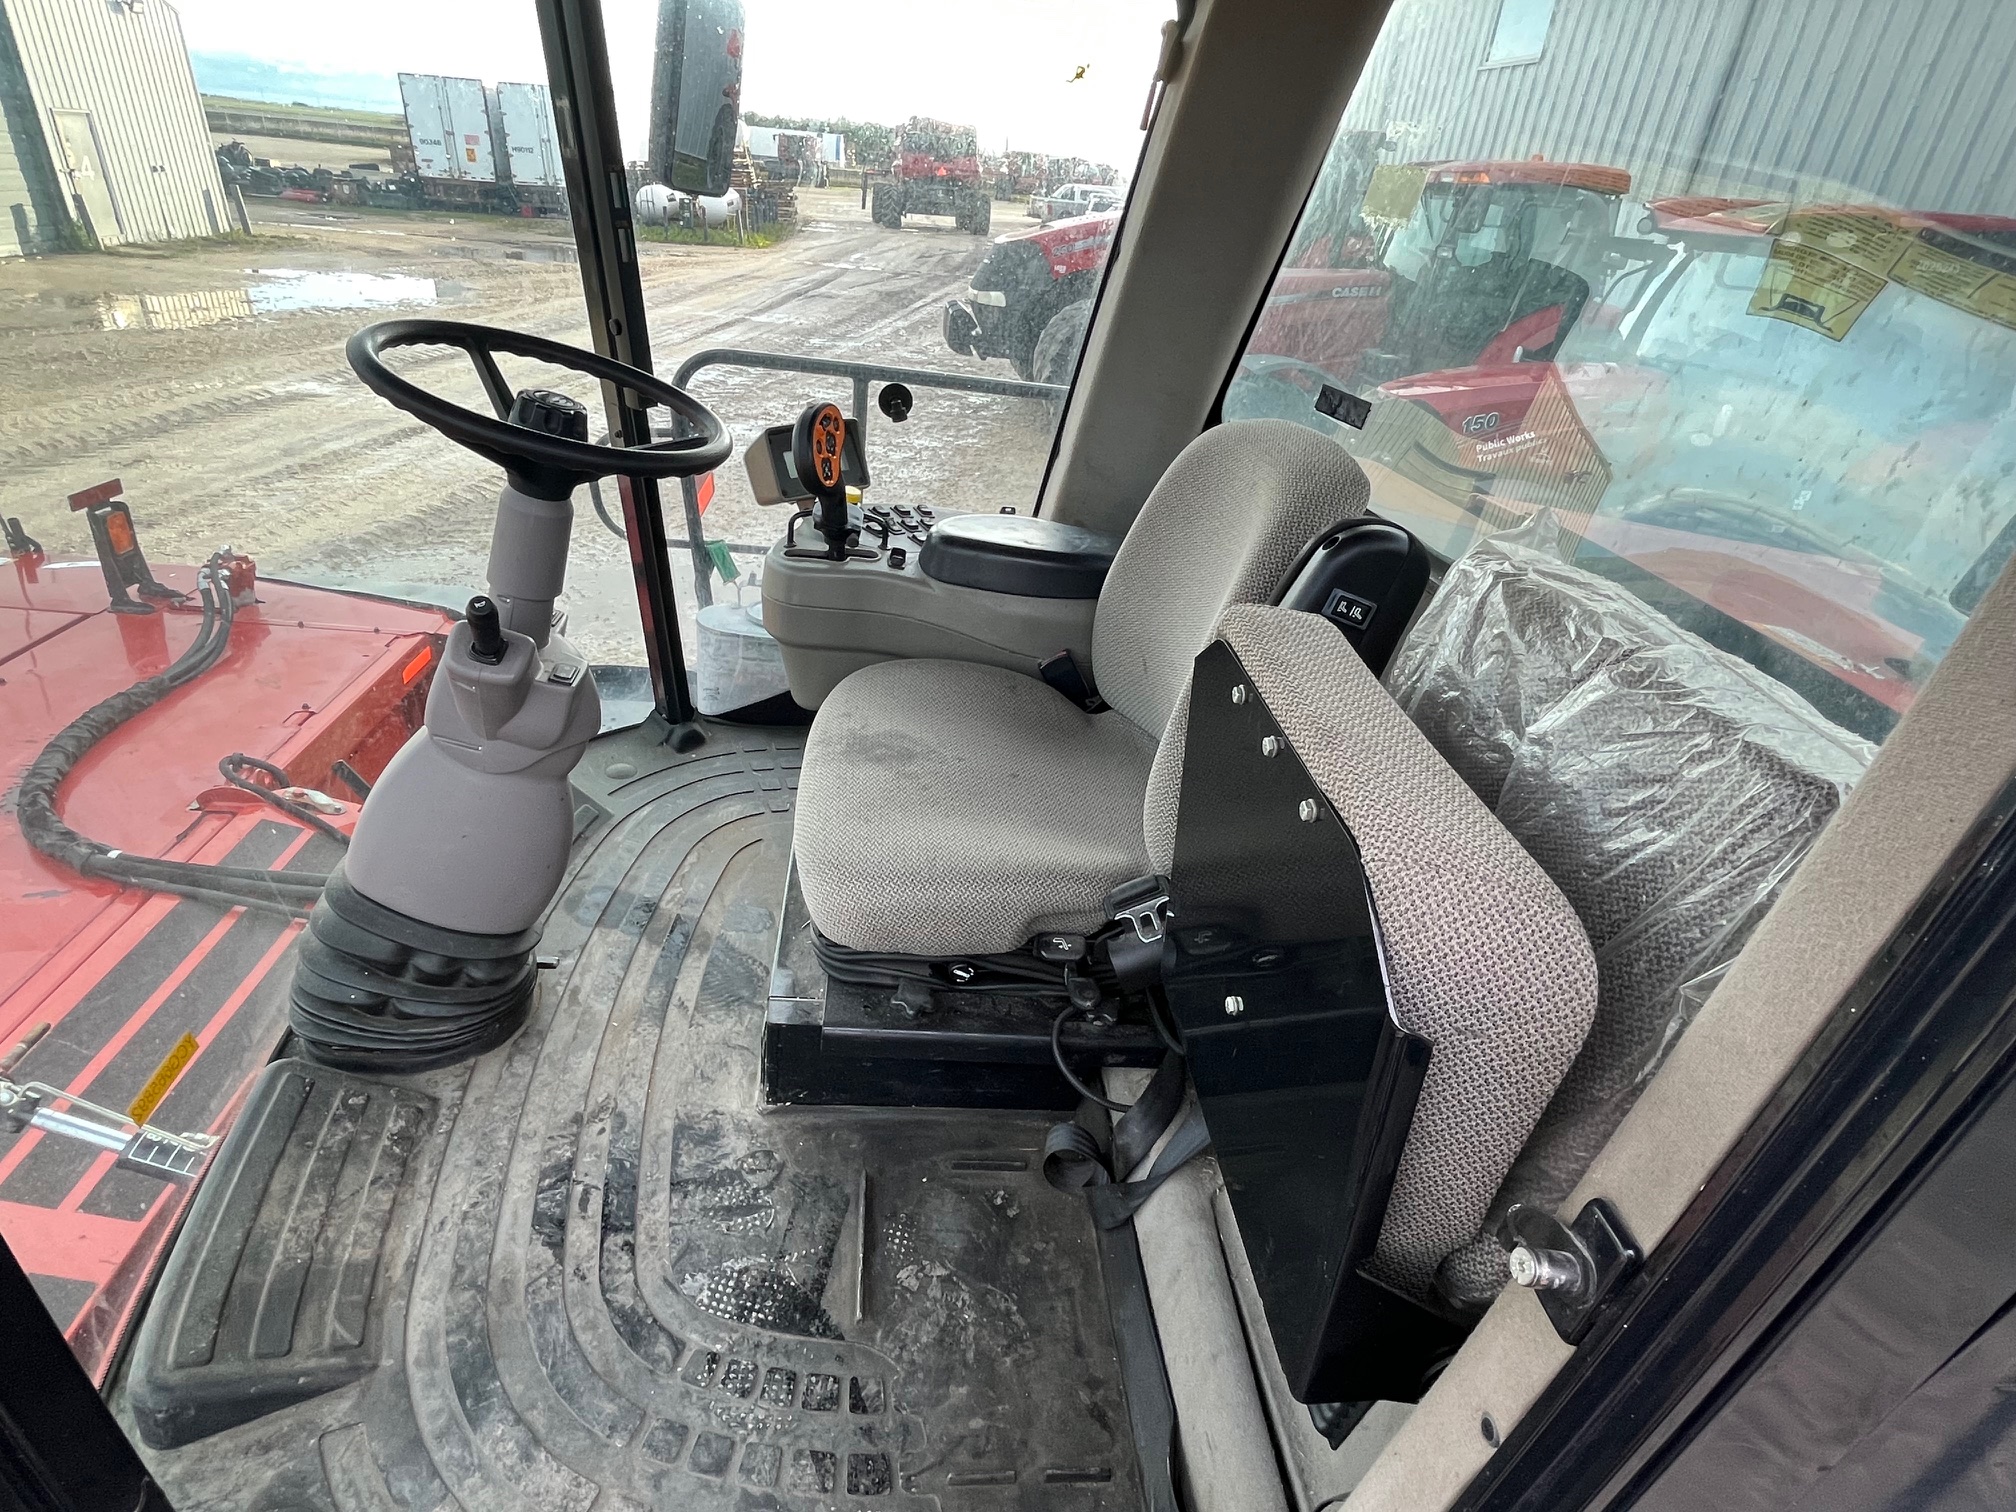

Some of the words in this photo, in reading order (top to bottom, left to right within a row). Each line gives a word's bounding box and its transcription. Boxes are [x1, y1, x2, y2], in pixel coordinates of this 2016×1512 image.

[1461, 411, 1501, 434] 150
[1476, 437, 1506, 453] Public
[1506, 430, 1536, 445] Works
[1477, 446, 1514, 463] Travaux
